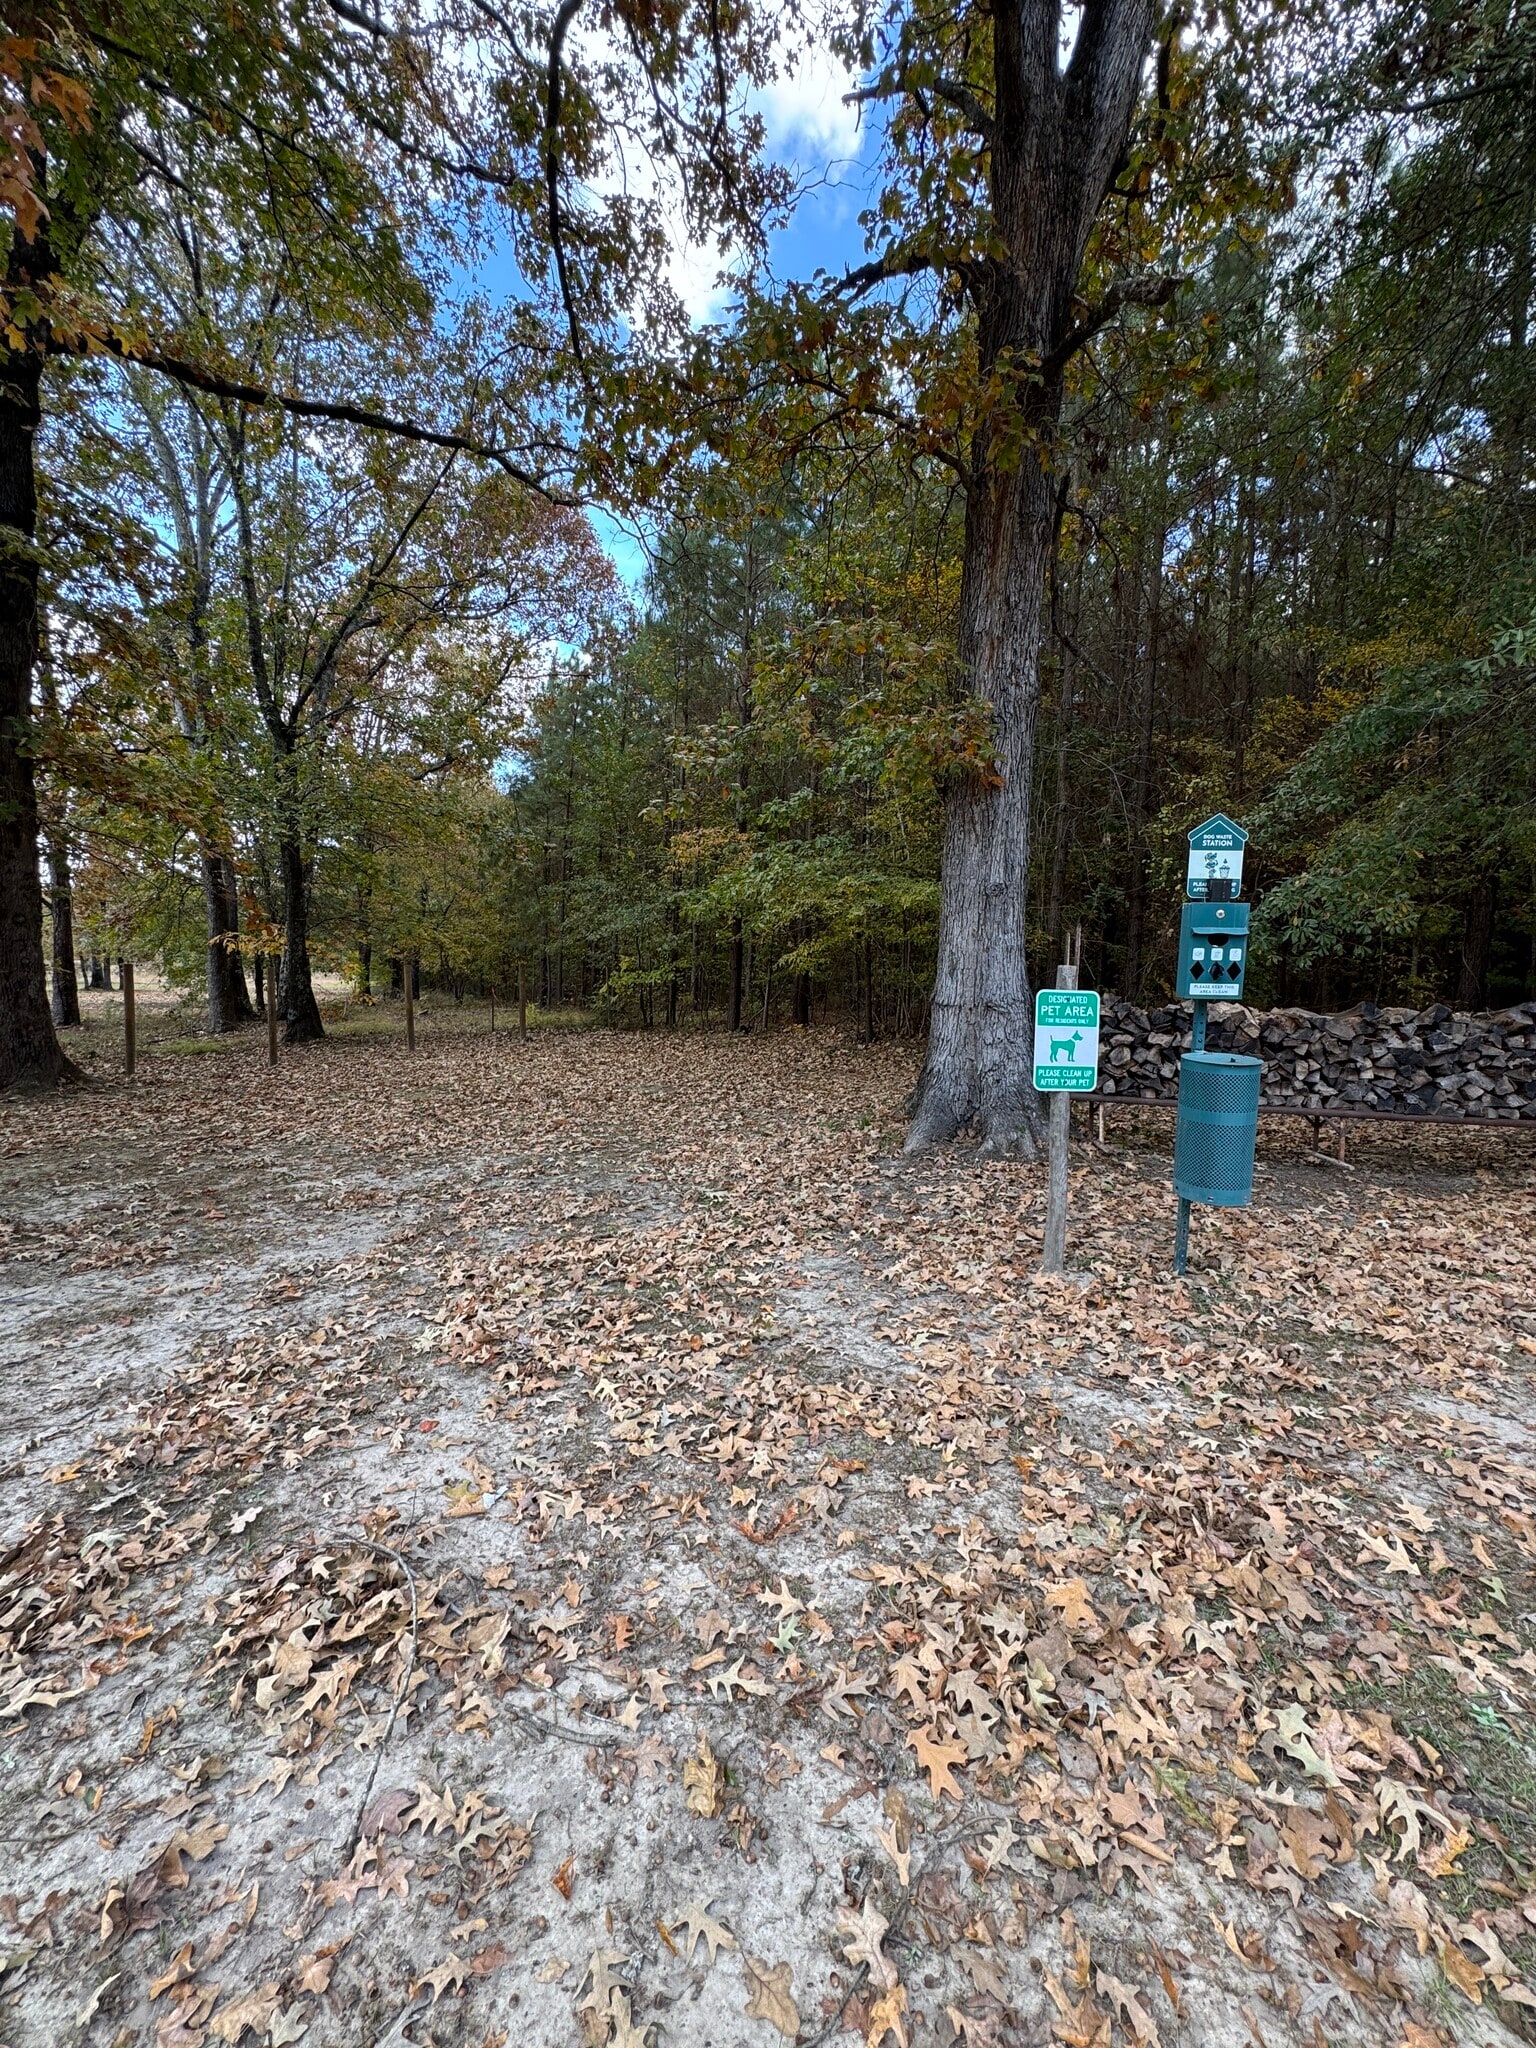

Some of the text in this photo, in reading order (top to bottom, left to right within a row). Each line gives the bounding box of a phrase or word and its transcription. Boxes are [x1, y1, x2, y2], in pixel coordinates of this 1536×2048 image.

[1202, 839, 1233, 847] STATION
[1049, 995, 1088, 1004] DESIGNATED
[1041, 1006, 1094, 1017] PET AREA
[1040, 1078, 1059, 1086] AFTER
